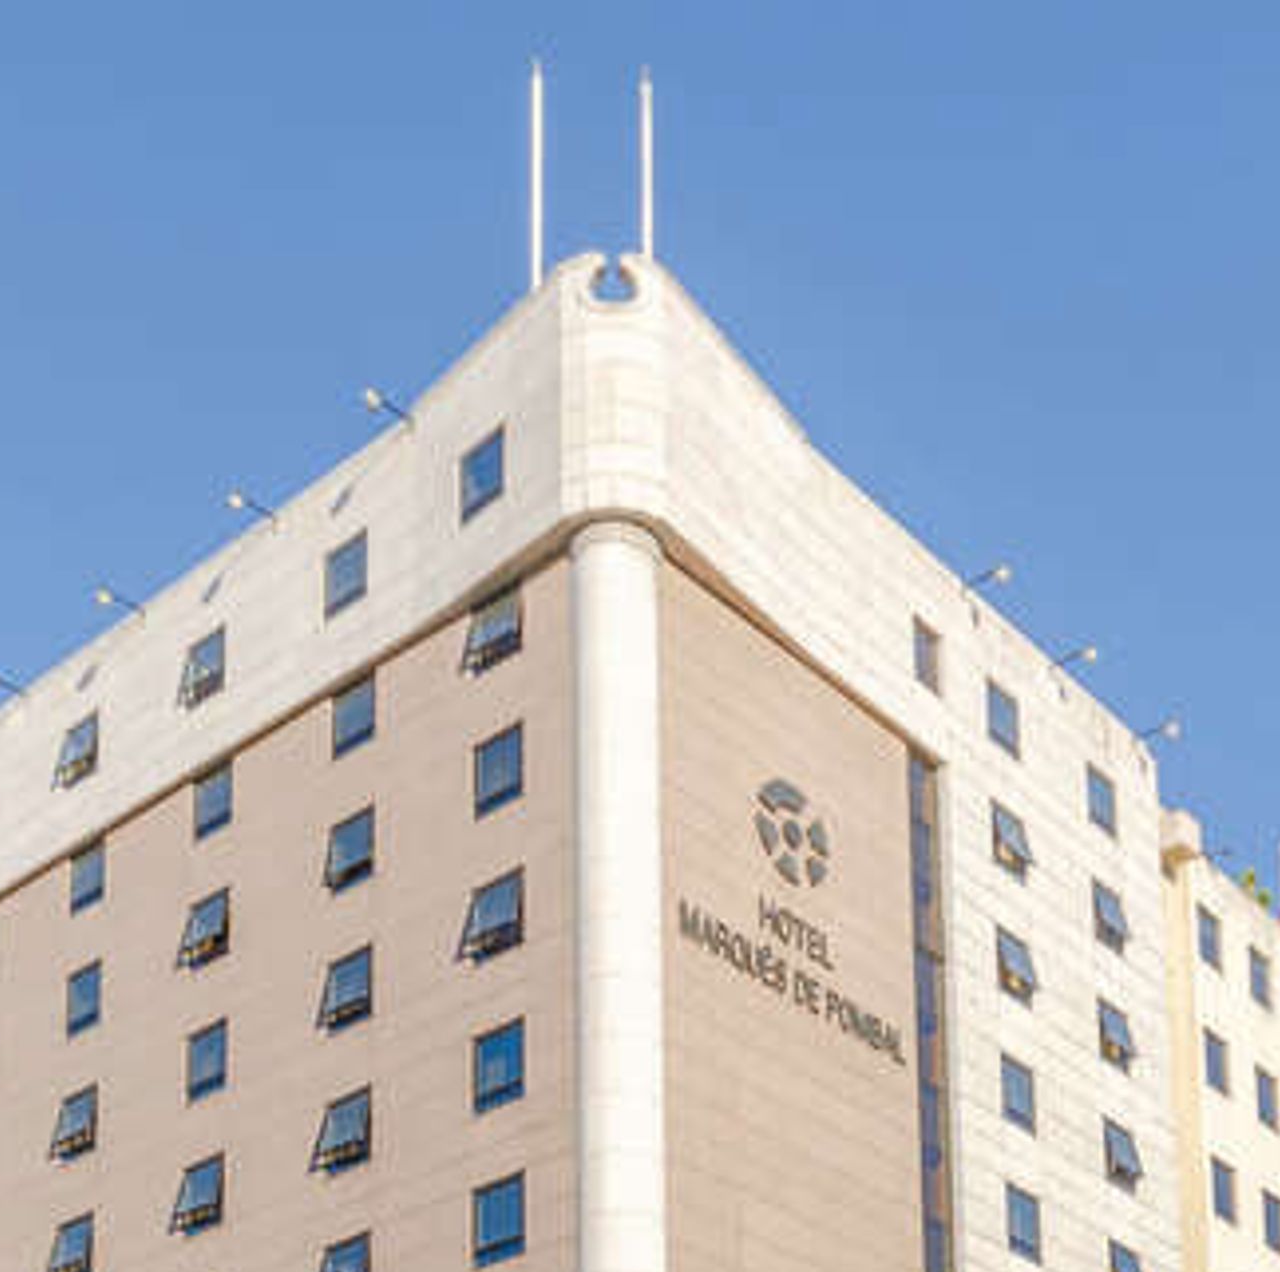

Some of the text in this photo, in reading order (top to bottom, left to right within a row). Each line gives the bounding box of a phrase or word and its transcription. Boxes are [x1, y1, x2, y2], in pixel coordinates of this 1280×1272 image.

[679, 897, 906, 1067] MARQUÊS DE POMBAL
[758, 892, 834, 971] HOTEL
